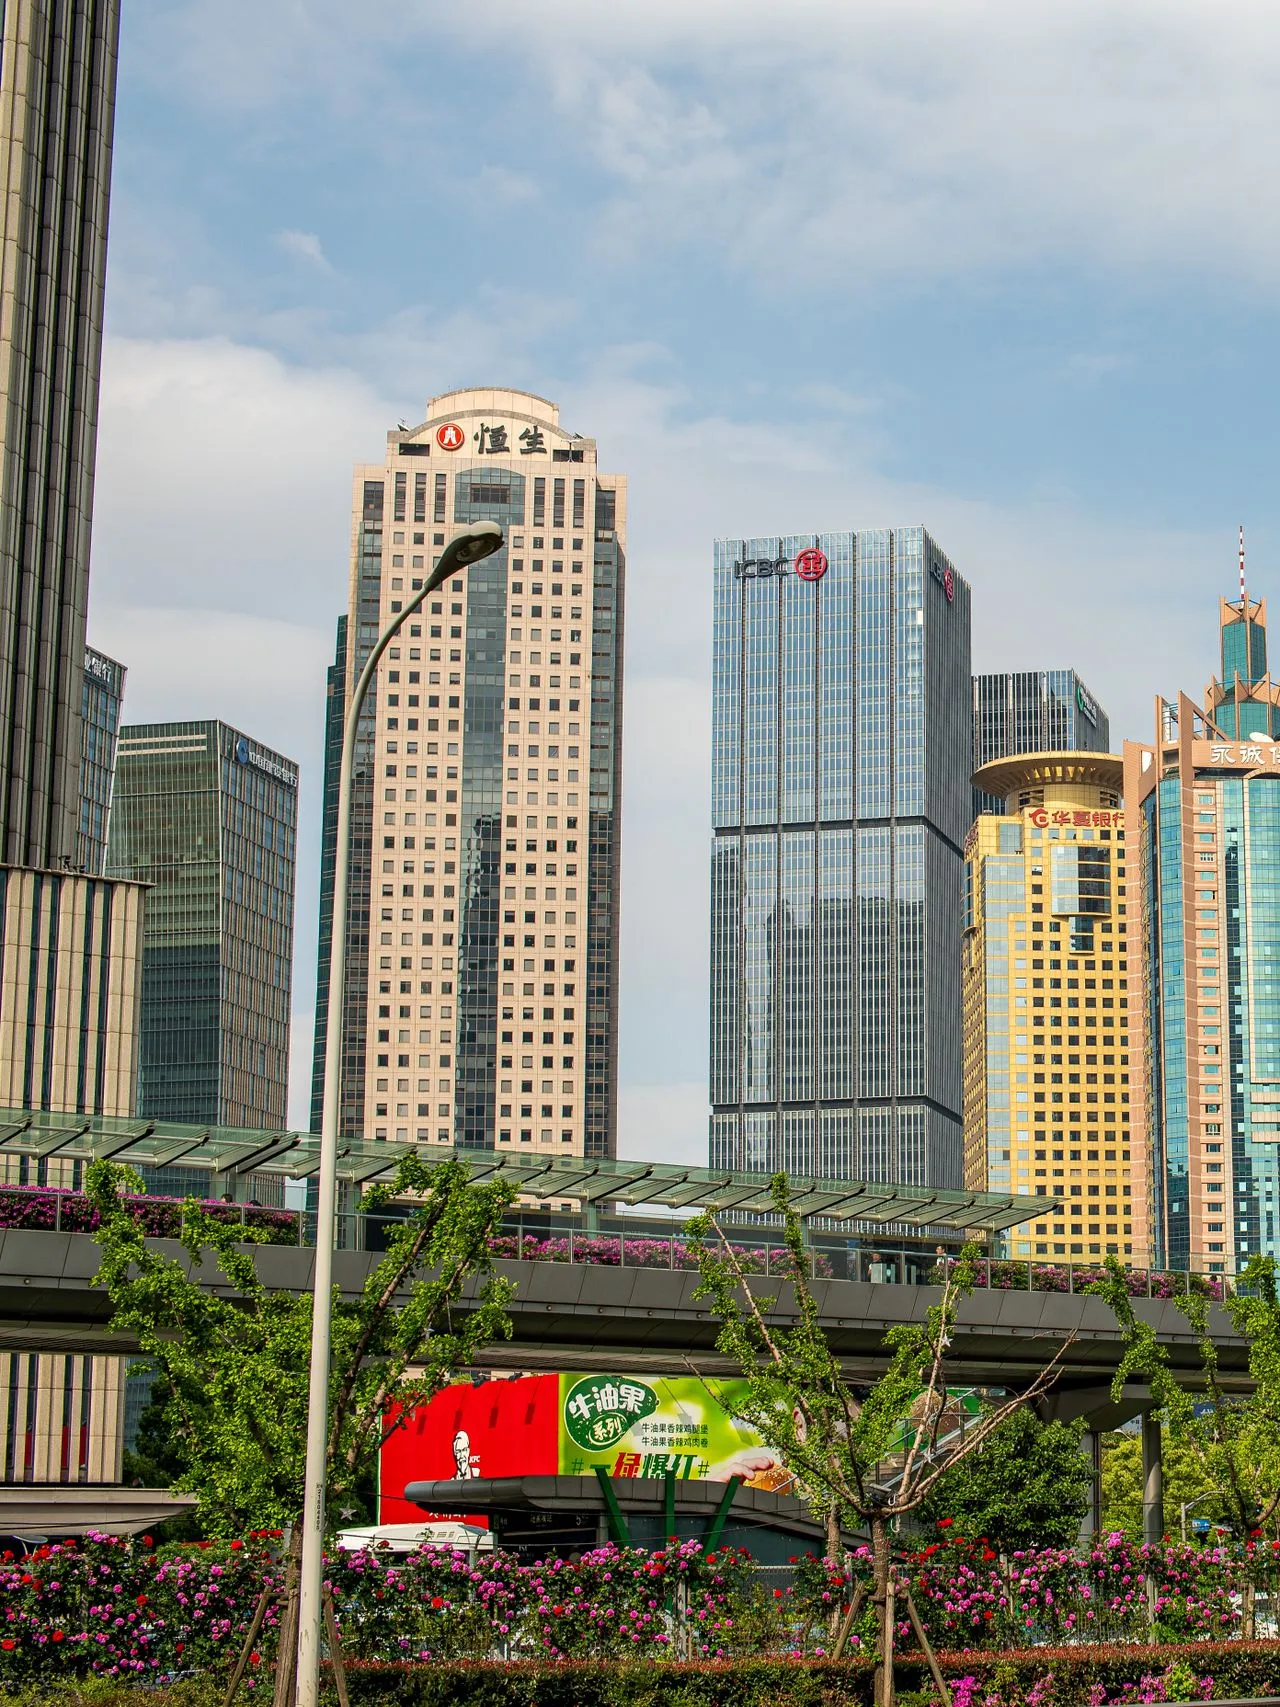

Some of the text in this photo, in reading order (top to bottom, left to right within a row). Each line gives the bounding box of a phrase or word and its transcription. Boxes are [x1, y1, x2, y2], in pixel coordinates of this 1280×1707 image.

[473, 422, 547, 455] 恒生
[734, 557, 788, 579] ICBC
[1052, 811, 1124, 828] 华夏银行
[568, 1383, 647, 1419] 牛油果
[592, 1417, 622, 1441] 系列
[642, 1422, 708, 1434] 牛油果香辣鸡腿堡
[642, 1437, 708, 1448] 牛油果香辣鸡肉卷
[469, 1455, 481, 1463] KFC
